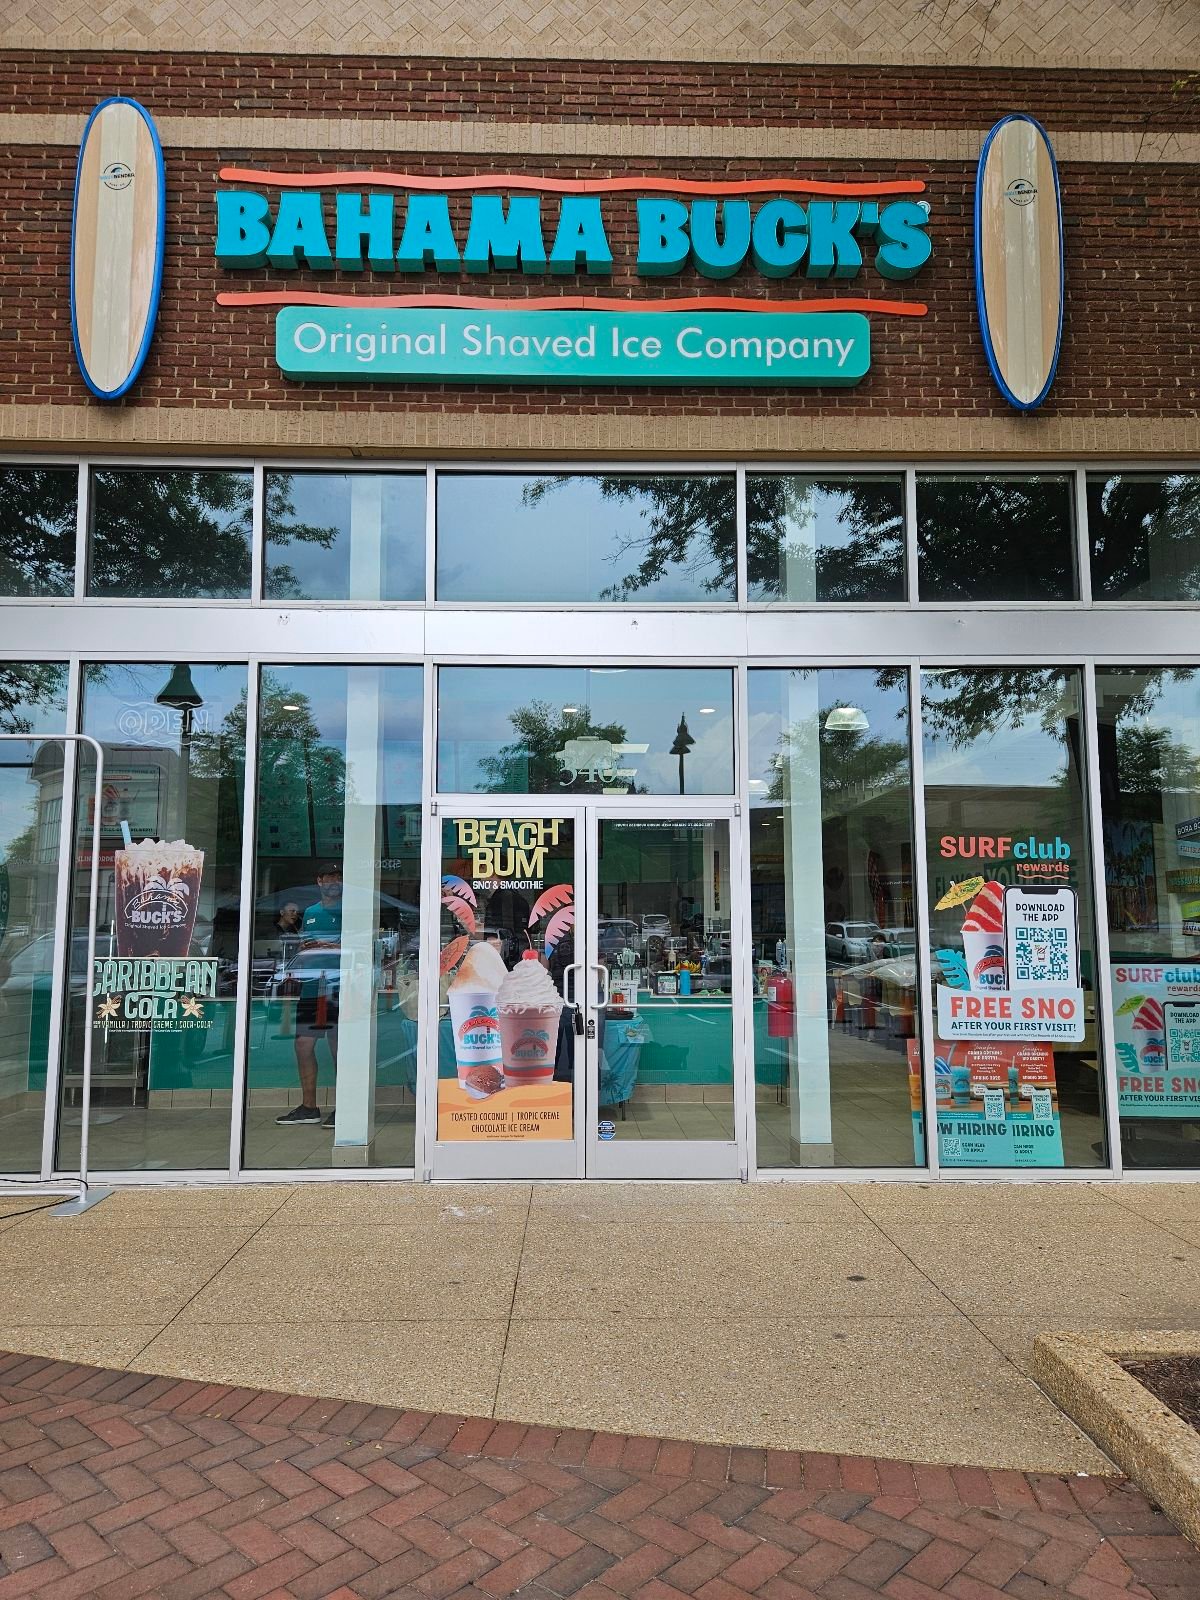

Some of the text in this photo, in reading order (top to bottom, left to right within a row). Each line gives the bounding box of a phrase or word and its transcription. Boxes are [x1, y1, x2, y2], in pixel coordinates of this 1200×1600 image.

[215, 190, 932, 279] BAHAMA BUCK'S
[293, 320, 856, 367] Original Shaved Ice Company
[118, 709, 209, 737] OPEN
[452, 818, 565, 850] BEACH
[940, 835, 1071, 859] SURF club
[467, 846, 549, 879] BUM
[1016, 861, 1070, 873] rewards
[493, 881, 500, 889] &
[501, 880, 544, 890] SMOOTHIE
[1015, 903, 1065, 912] DOWNLOAD
[131, 910, 183, 924] BUCK'S
[1023, 914, 1059, 922] THE APP
[92, 960, 218, 998] CARIBBEAN
[1115, 968, 1163, 983] SURF
[124, 991, 178, 1019] COLA
[950, 996, 1076, 1020] FREE SNO
[102, 1020, 126, 1029] VANILLA
[131, 1020, 151, 1029] TROPIC
[153, 1020, 173, 1029] CREME
[951, 1021, 1076, 1032] AFTER YOUR FIRST VISIT!
[1119, 1076, 1200, 1094] FREE SN
[1120, 1094, 1143, 1102] AFTER
[451, 1111, 560, 1121] TOASTED COCONUT TROPIC CREME
[471, 1123, 540, 1133] CHOCOLATE ICE CREAM
[957, 1122, 1007, 1136] HIRING
